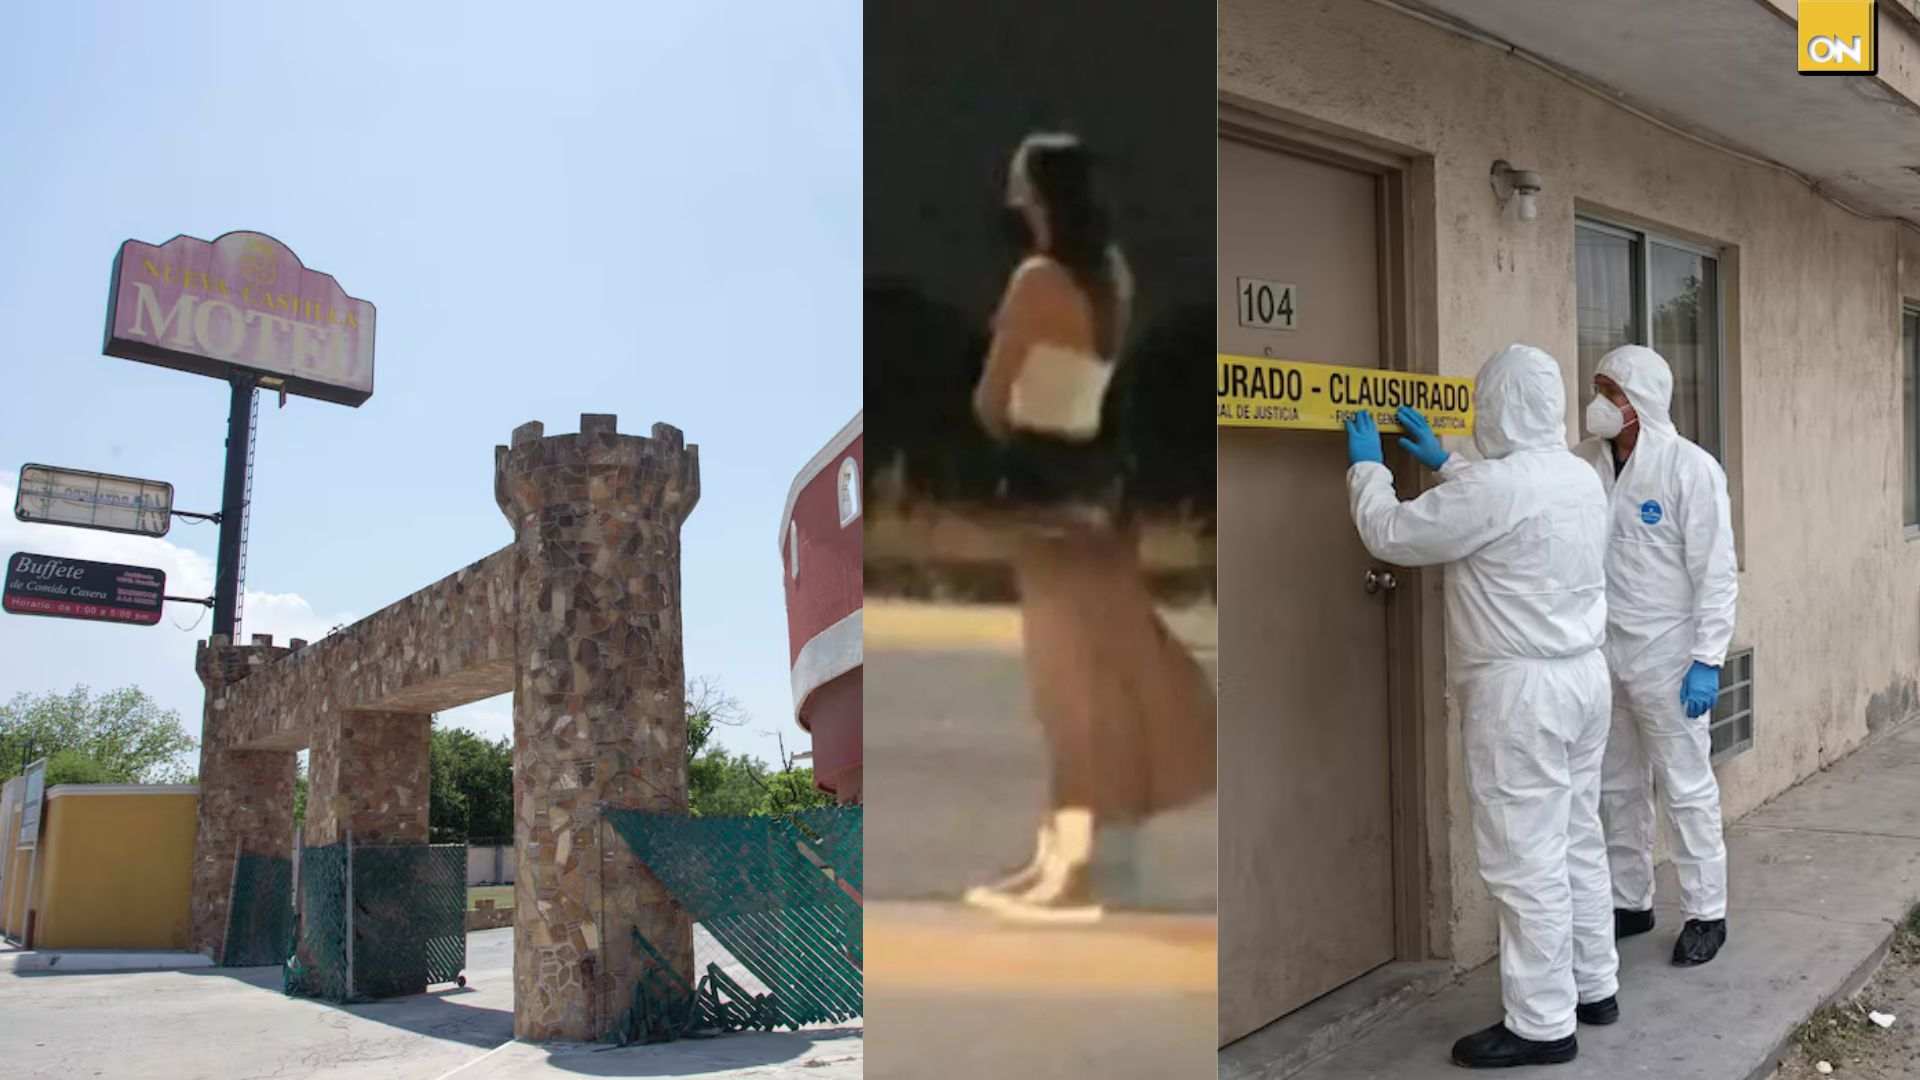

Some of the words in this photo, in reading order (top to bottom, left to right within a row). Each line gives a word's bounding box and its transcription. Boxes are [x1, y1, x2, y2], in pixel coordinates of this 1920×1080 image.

[1243, 282, 1294, 326] 104
[128, 281, 361, 382] MOTEL
[1329, 373, 1470, 413] CLAUSURADO
[1236, 404, 1250, 419] DE
[1254, 405, 1299, 421] JUSTICIA
[15, 556, 85, 580] Buffete
[10, 579, 24, 590] de
[26, 580, 69, 595] Comida
[70, 586, 108, 600] Casera
